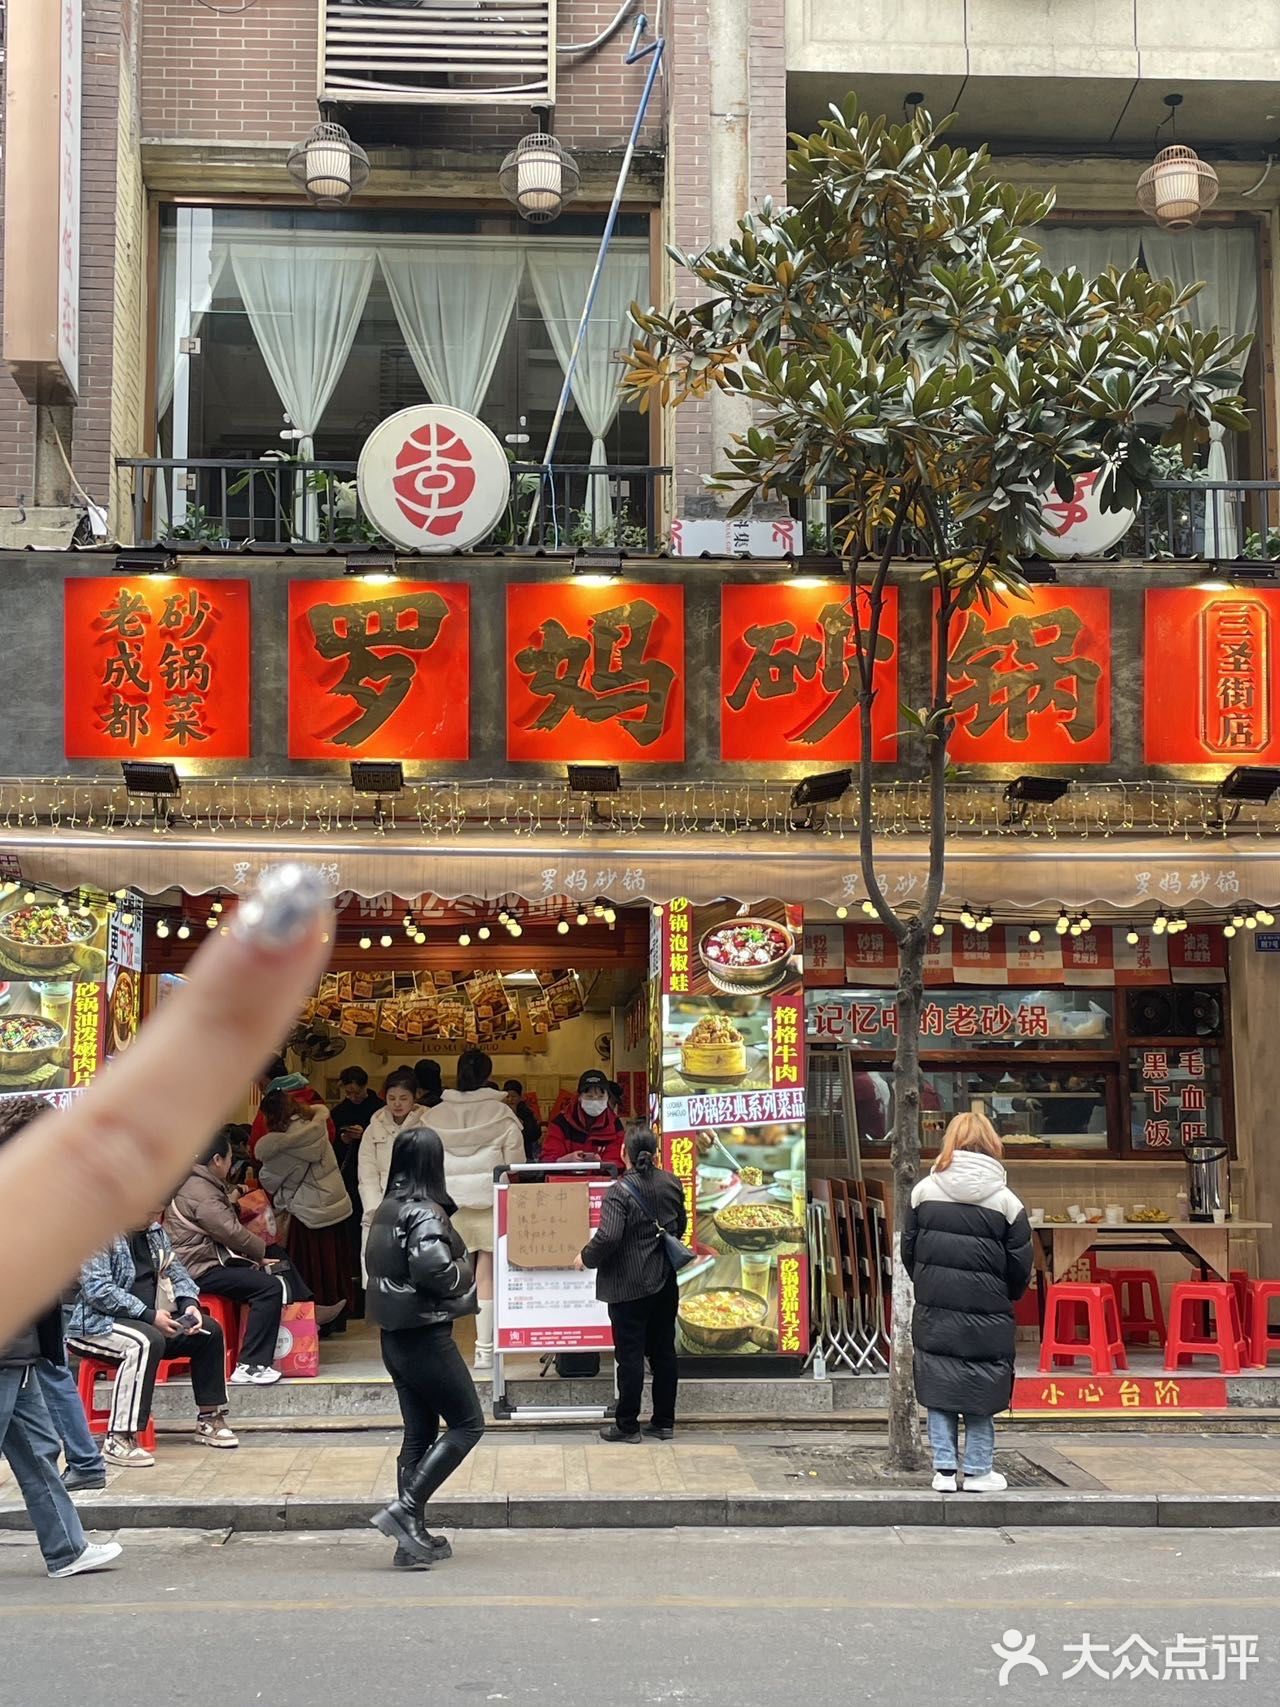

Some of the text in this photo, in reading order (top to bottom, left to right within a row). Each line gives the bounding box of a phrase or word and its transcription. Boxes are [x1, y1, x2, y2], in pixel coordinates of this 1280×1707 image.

[100, 587, 151, 747] 老成都
[158, 587, 212, 747] 砂锅菜
[308, 591, 1101, 748] 罗妈砂锅
[1216, 605, 1255, 749] 三圣街店
[233, 861, 340, 886] 罗锅
[541, 868, 645, 893] 罗妈砂锅
[1135, 870, 1239, 896] 罗妈砂锅
[669, 897, 689, 992] 砂锅泡椒蛙
[774, 1005, 798, 1083] 格格牛肉
[814, 1003, 1050, 1037] 记忆中的老砂锅
[688, 1091, 806, 1126] 砂锅经典系列菜品
[1143, 1051, 1171, 1148] 黑下饭
[1178, 1050, 1207, 1147] 毛血旺
[780, 1258, 800, 1352] 砂锅番茄丸子汤
[1041, 1380, 1181, 1407] 小心台阶
